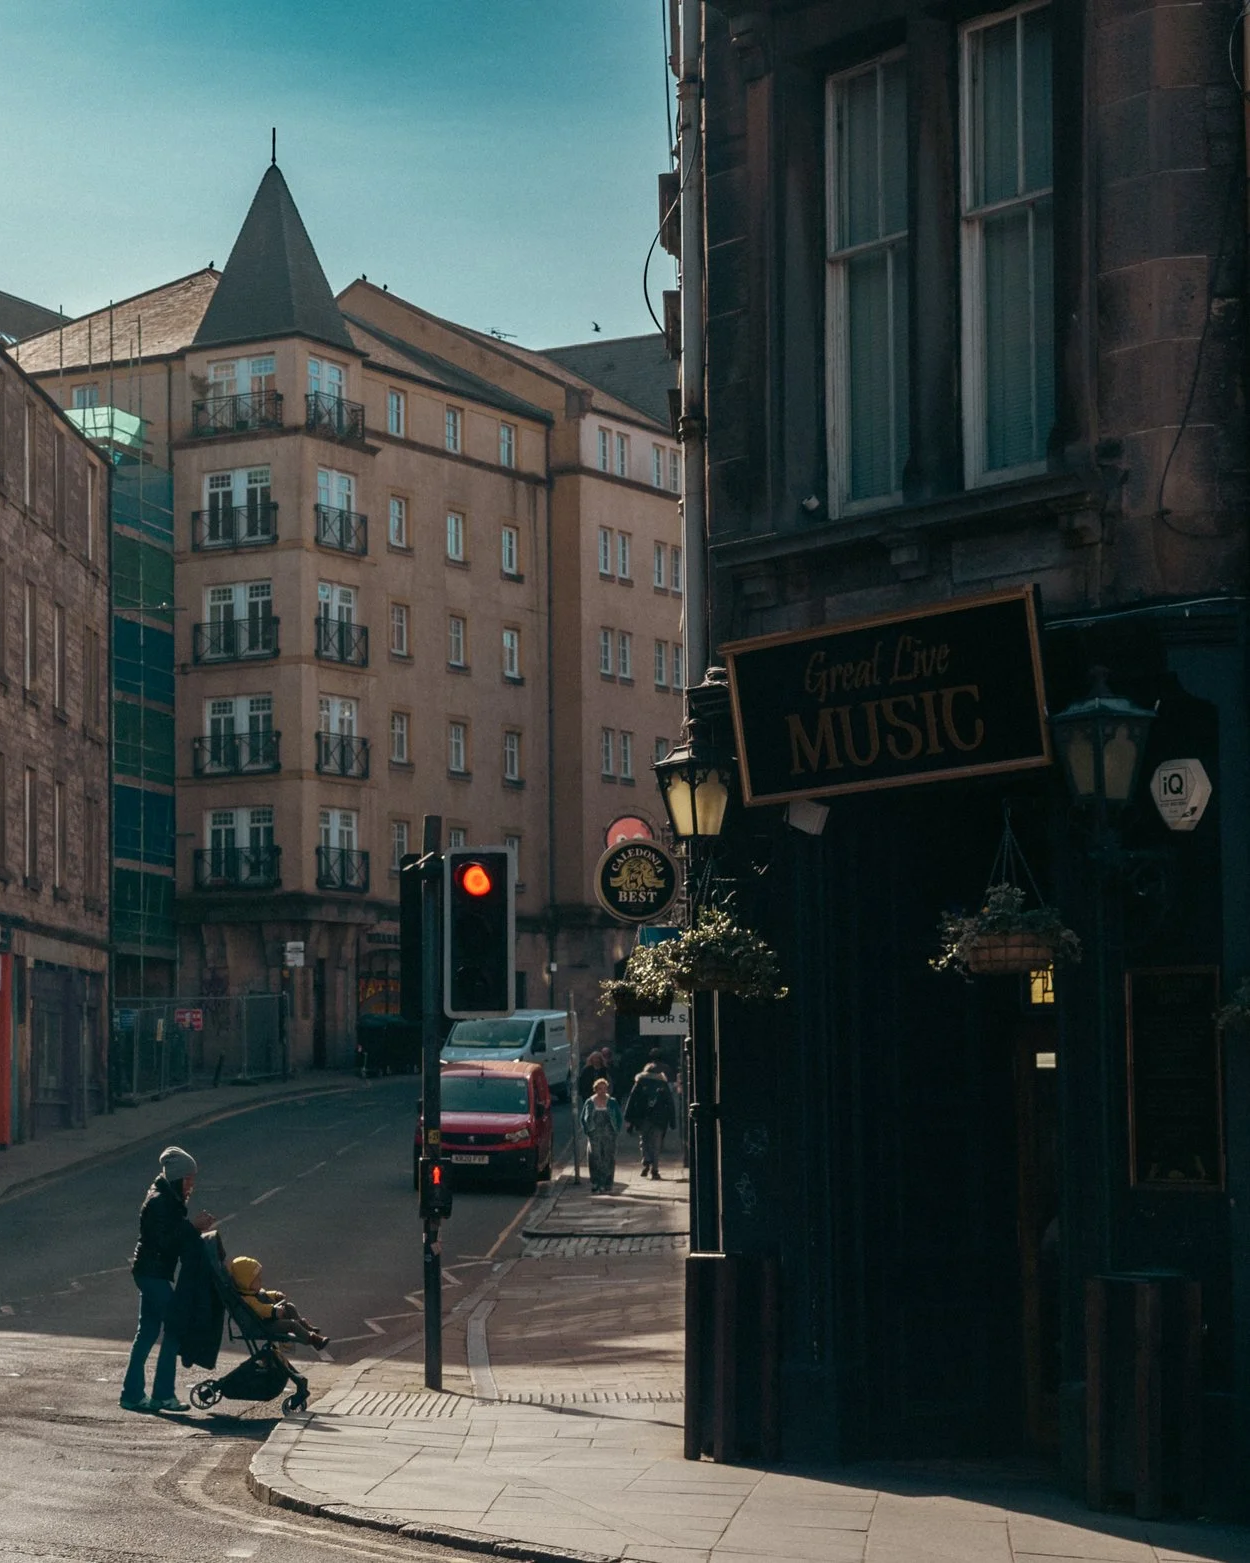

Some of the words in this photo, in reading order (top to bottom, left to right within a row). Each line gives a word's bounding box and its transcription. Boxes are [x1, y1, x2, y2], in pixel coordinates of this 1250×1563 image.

[804, 641, 884, 703] Great
[889, 634, 950, 683] Live
[785, 684, 985, 774] MUSIC
[1163, 773, 1183, 795] iQ
[611, 848, 664, 873] CALEDONIA
[618, 891, 657, 903] BEST
[651, 1014, 675, 1024] FOR
[679, 1014, 689, 1024] S
